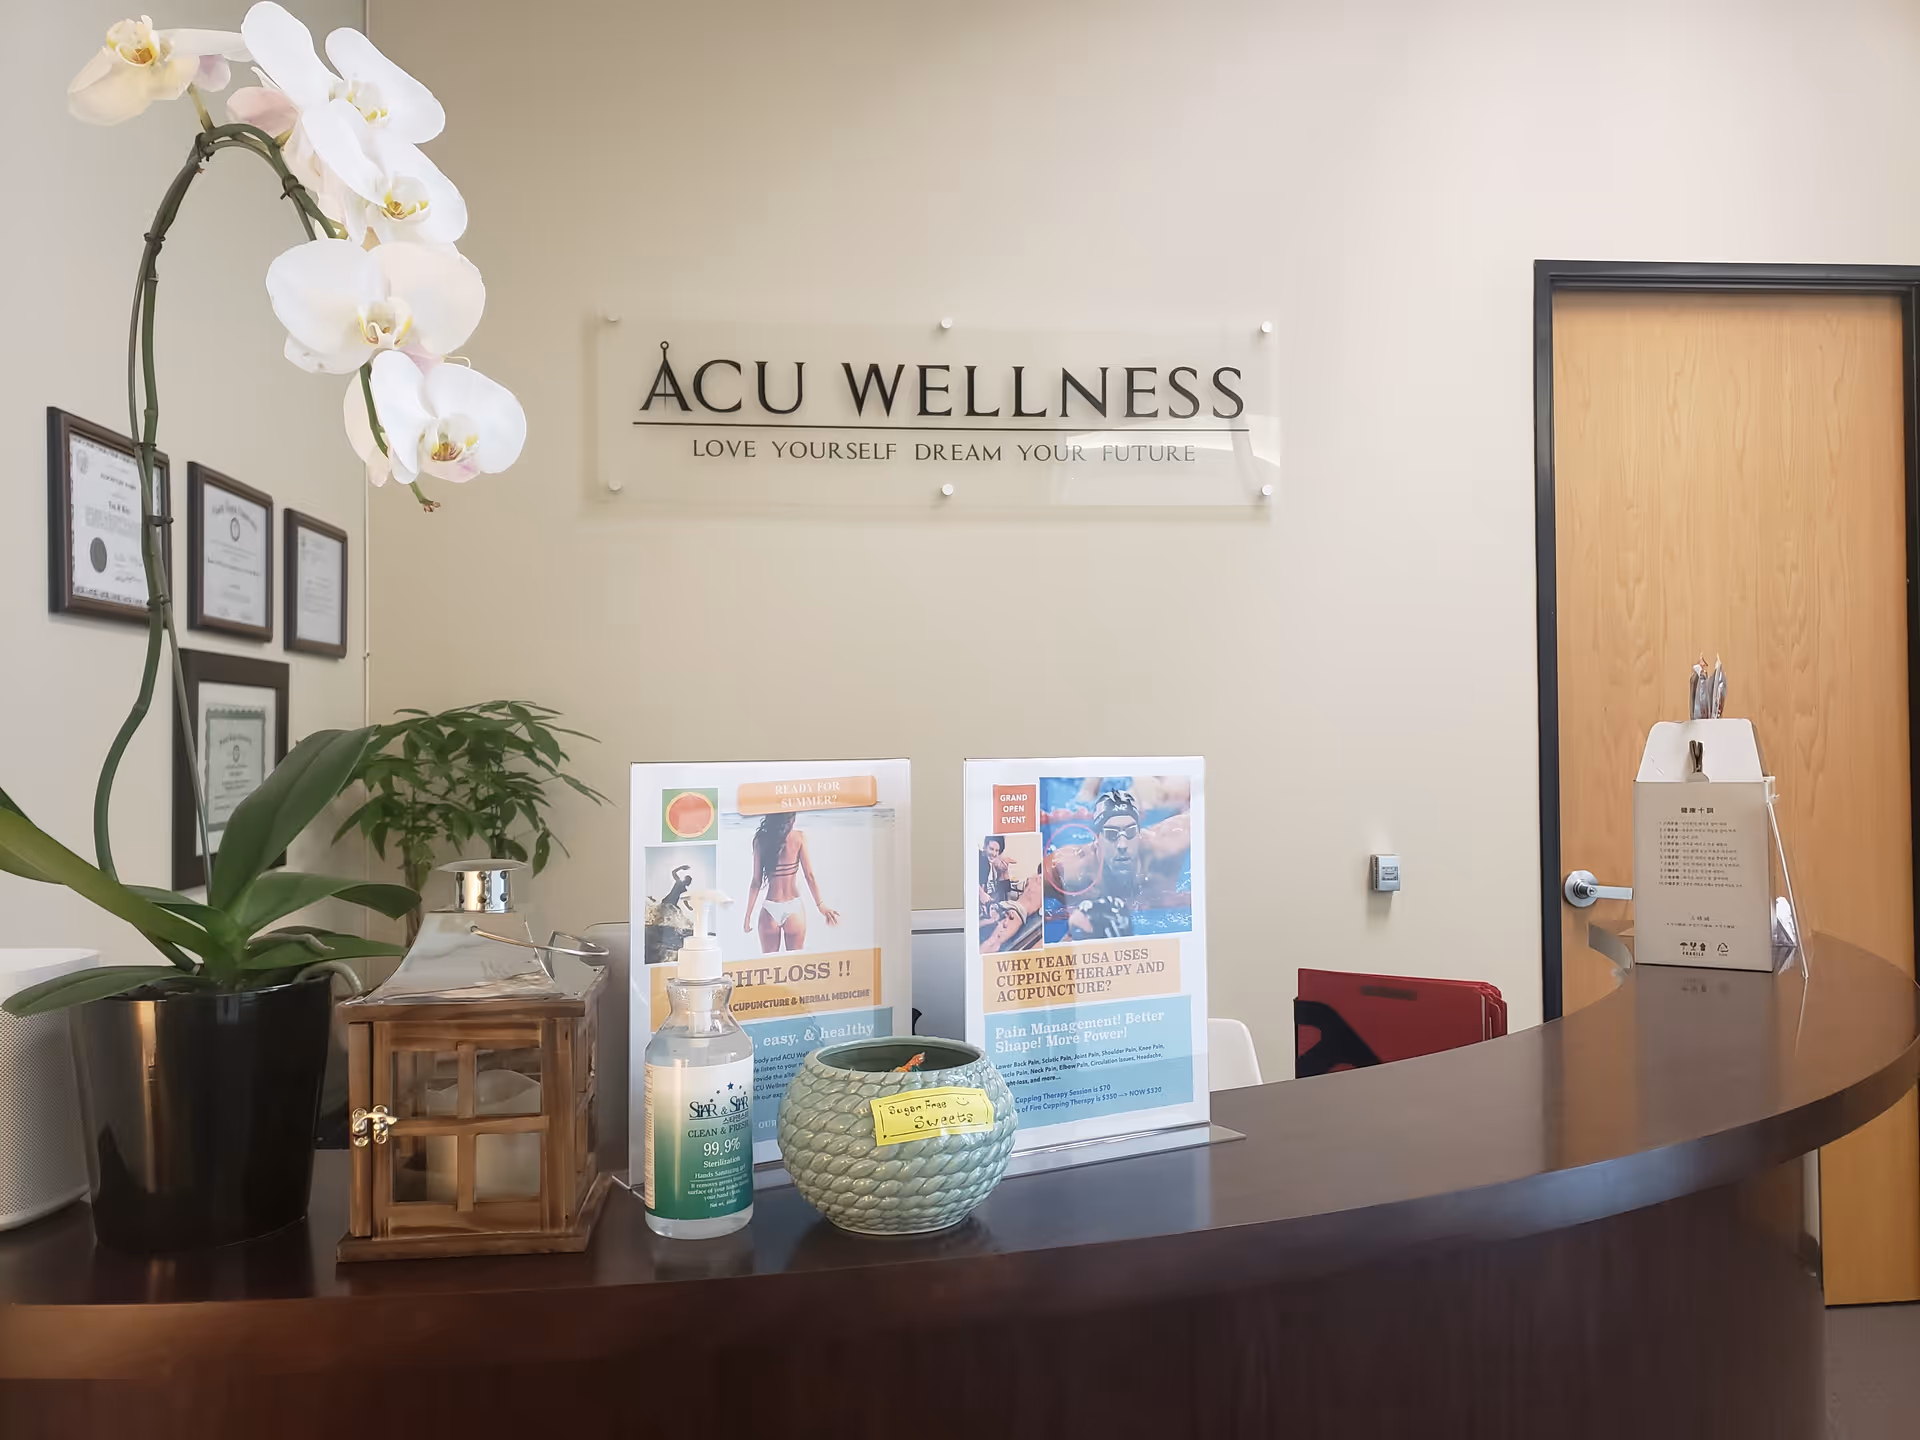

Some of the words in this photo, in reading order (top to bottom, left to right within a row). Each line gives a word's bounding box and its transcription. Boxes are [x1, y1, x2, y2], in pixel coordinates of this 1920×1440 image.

[639, 341, 805, 415] ACU
[841, 362, 1245, 420] WELLNESS
[693, 439, 756, 458] LOVE
[771, 440, 897, 461] YOURSELF
[915, 443, 1002, 462] DREAM
[1017, 444, 1085, 463] YOUR
[1102, 444, 1196, 463] FUTURE
[775, 783, 813, 795] READY
[817, 781, 840, 792] FOR
[781, 794, 838, 808] SUMMER?
[1000, 794, 1028, 802] GRAND
[1002, 805, 1025, 813] OPEN
[1001, 816, 1026, 824] EVENT
[997, 958, 1031, 973] WHY
[1036, 954, 1077, 969] TEAM
[1082, 952, 1110, 964] USA
[1114, 948, 1149, 961] USES
[996, 970, 1061, 988] CUPPING
[1065, 963, 1132, 981] THERAPY
[1136, 961, 1165, 974] AND
[790, 997, 799, 1005] &
[799, 993, 830, 1005] HERBAL
[831, 989, 870, 1000] MEDICINE
[996, 980, 1112, 1003] ACUPUNCTURE?
[995, 1026, 1027, 1039] Pain
[1030, 1013, 1121, 1035] Management!
[1125, 1011, 1165, 1025] Better
[763, 1033, 799, 1046] easy,
[803, 1029, 815, 1041] &
[820, 1023, 874, 1040] healthy
[995, 1036, 1041, 1053] Shape!
[1046, 1033, 1080, 1047] More
[1084, 1027, 1128, 1042] Power!
[782, 1053, 795, 1061] ACU
[995, 1062, 1013, 1070] Lower
[1013, 1060, 1027, 1068] Back
[1028, 1058, 1041, 1066] Pain,
[1060, 1054, 1073, 1062] Pain,
[1101, 1048, 1125, 1056] Shoulder
[1016, 1069, 1030, 1077] Pain,
[1030, 1067, 1044, 1075] Neck
[1045, 1065, 1059, 1073] Pain,
[1059, 1063, 1076, 1071] Elbow
[1090, 1058, 1118, 1067] Circulation
[1118, 1055, 1136, 1063] Issues,
[1136, 1053, 1163, 1061] Headache,
[760, 1065, 776, 1073] listen
[1015, 1094, 1042, 1104] Cupping
[1042, 1091, 1068, 1101] Therapy
[1069, 1087, 1092, 1096] Session
[1099, 1083, 1111, 1092] $70
[1042, 1101, 1070, 1110] Cupping
[1071, 1097, 1095, 1106] Therapy
[1129, 1088, 1145, 1097] NOW
[721, 1106, 729, 1115] &
[888, 1105, 922, 1116] Sugar
[925, 1099, 947, 1110] Free
[913, 1111, 974, 1129] Sweets
[687, 1128, 718, 1138] CLEAN
[720, 1126, 727, 1135] &
[703, 1137, 741, 1157] 99.9%
[703, 1155, 741, 1169] Sterilization
[694, 1171, 714, 1179] Hands
